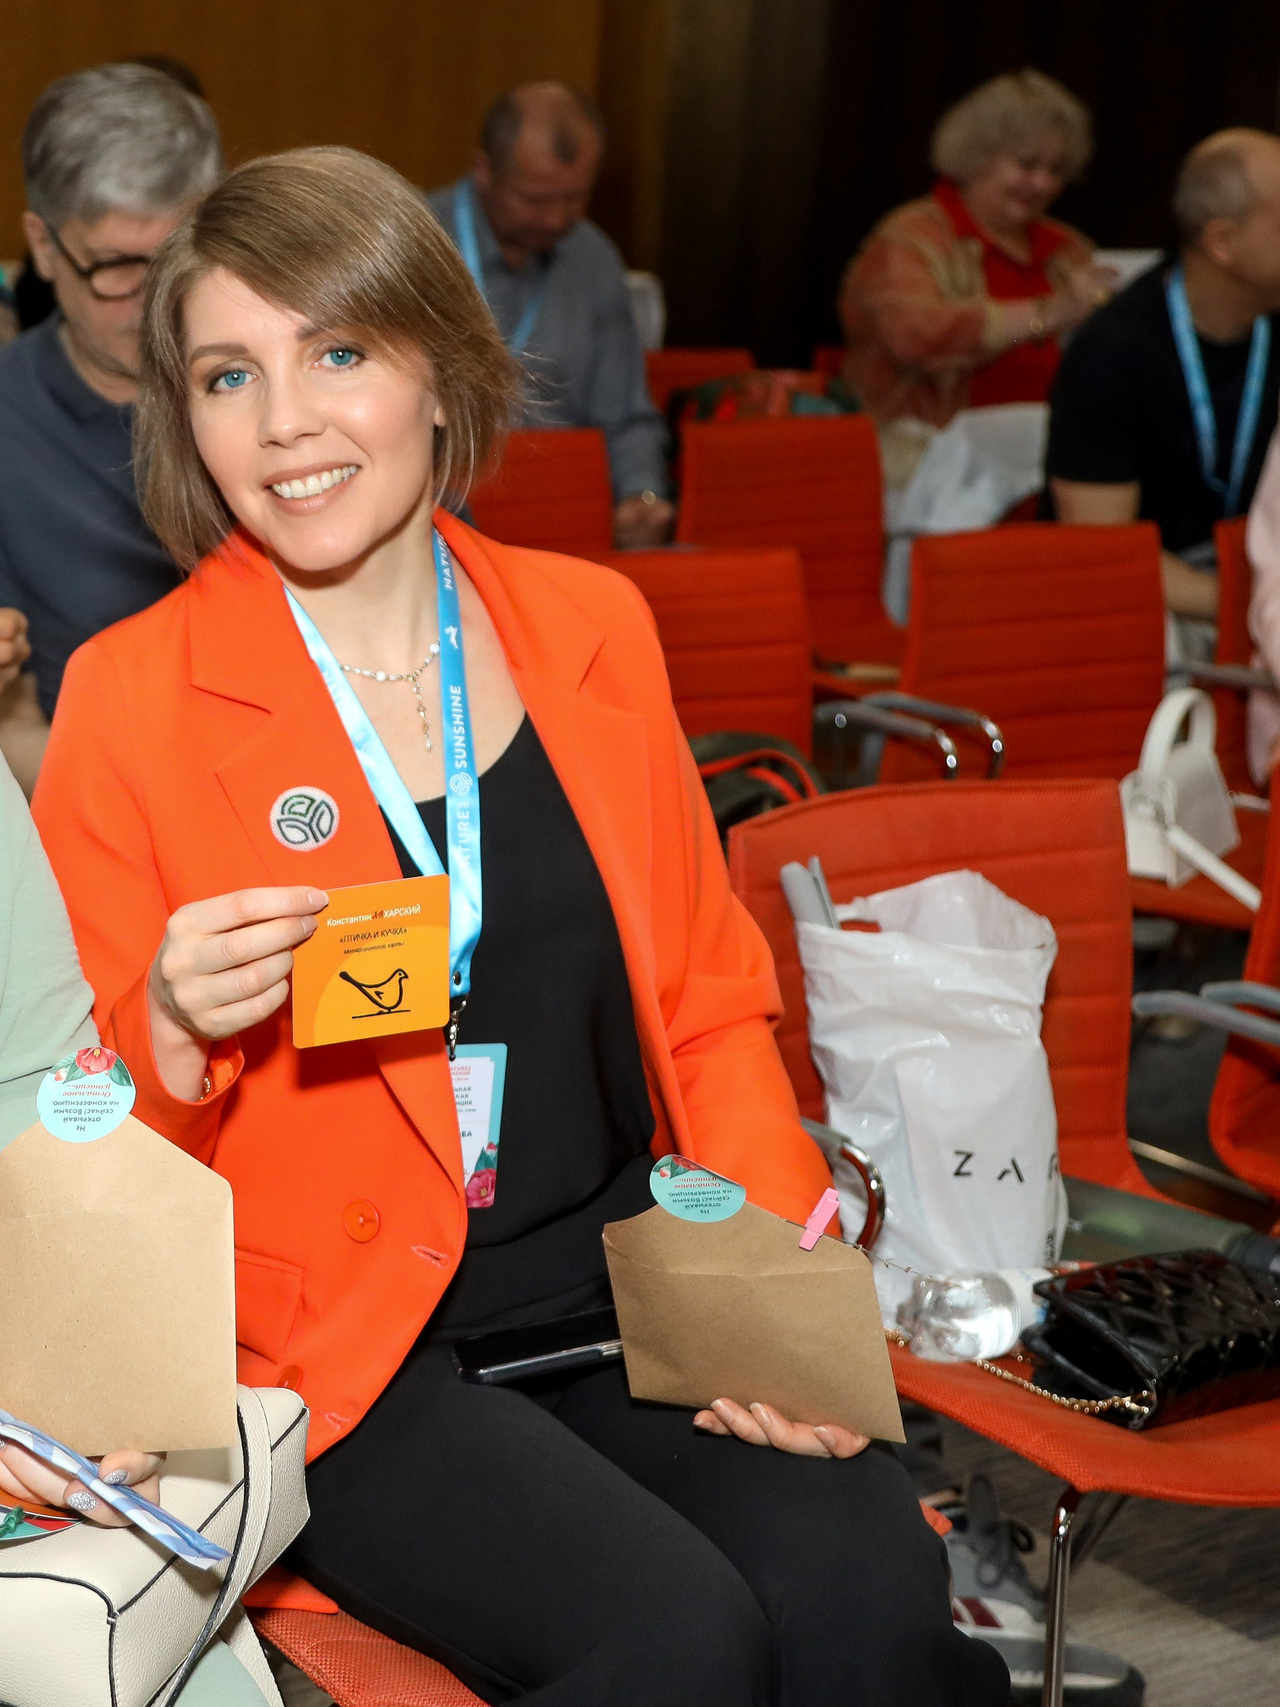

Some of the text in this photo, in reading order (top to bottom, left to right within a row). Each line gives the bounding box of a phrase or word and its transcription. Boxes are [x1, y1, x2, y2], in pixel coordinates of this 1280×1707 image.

[450, 684, 468, 769] SUNSHINE
[326, 913, 372, 927] Константин
[339, 927, 408, 943] «ПТИЧКА И КУЧКА»
